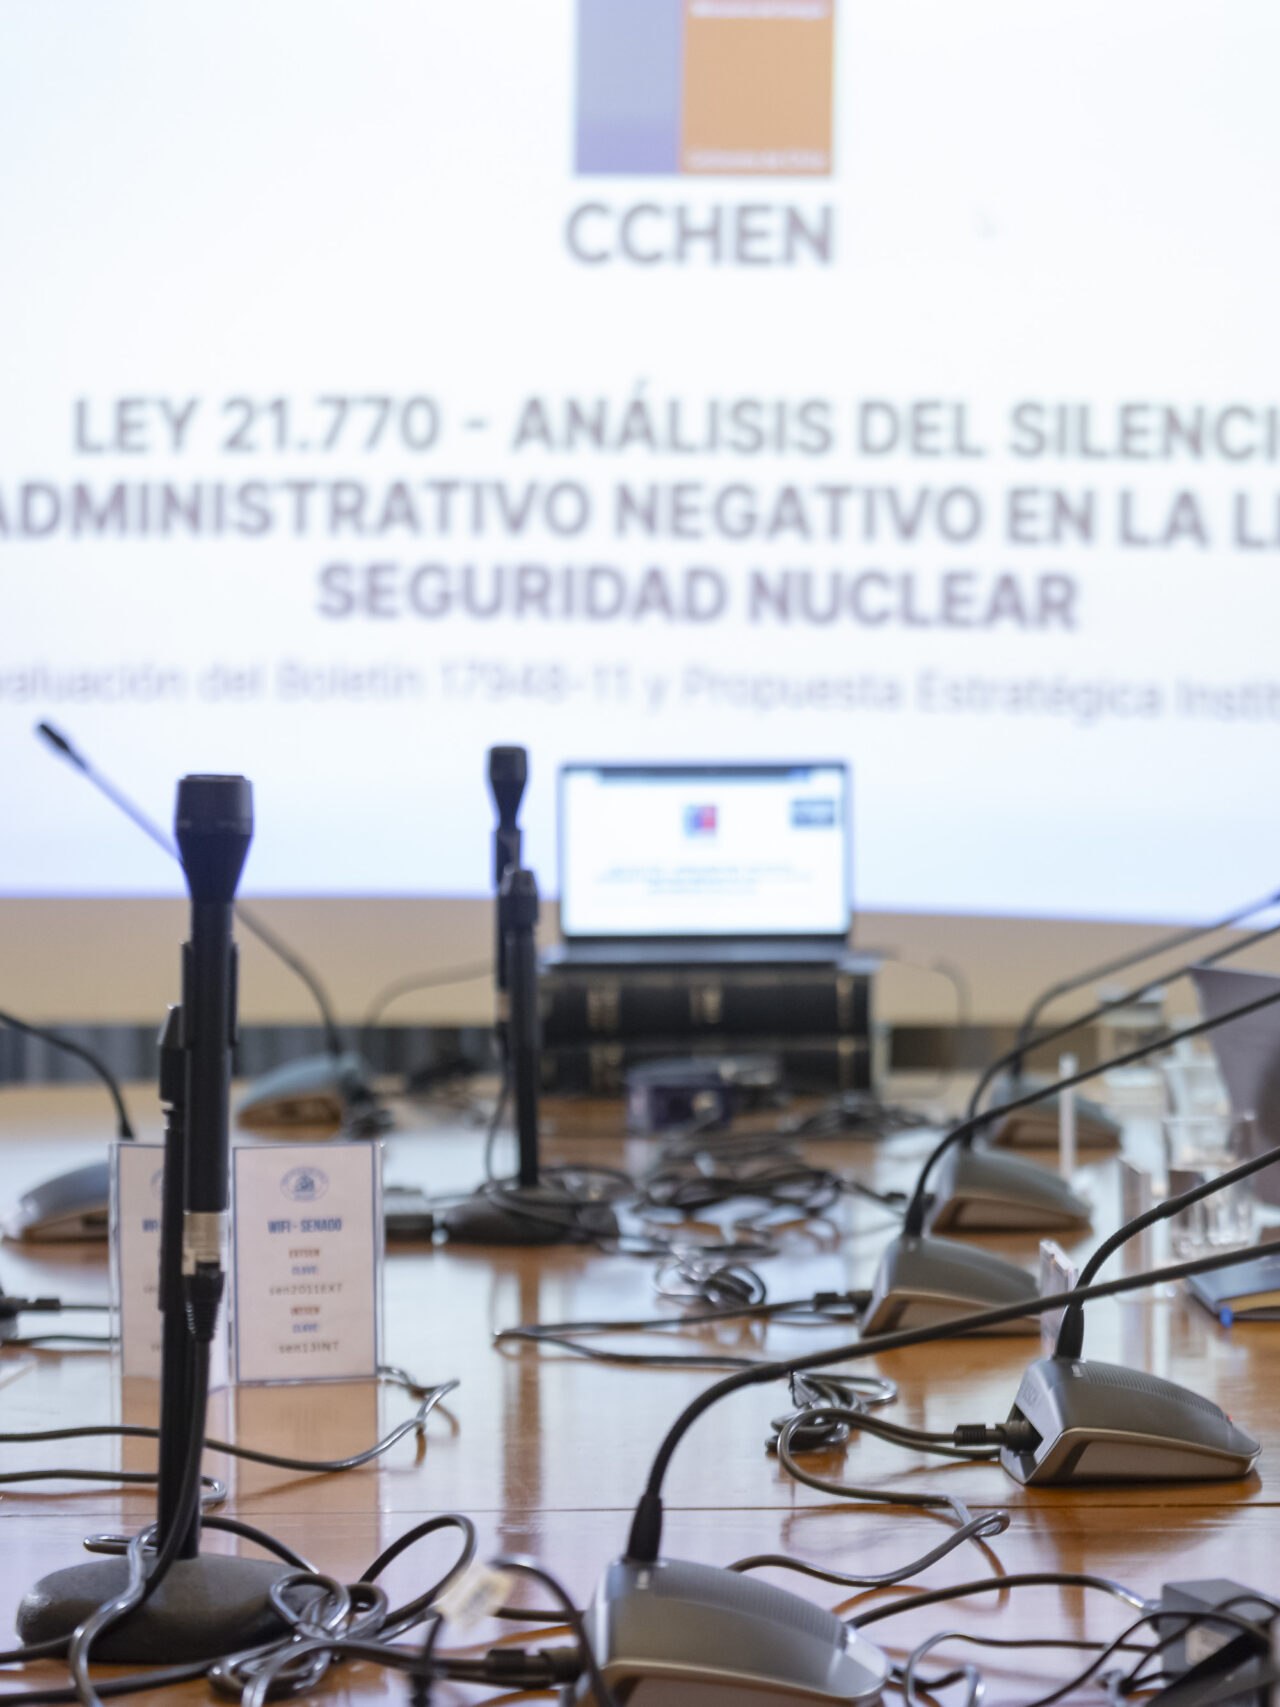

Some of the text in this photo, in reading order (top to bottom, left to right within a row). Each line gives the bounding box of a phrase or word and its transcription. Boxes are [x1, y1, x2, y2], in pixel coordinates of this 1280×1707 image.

[564, 201, 834, 266] CCHEN
[74, 397, 199, 454] LEY
[222, 396, 441, 453] 21.770
[512, 379, 834, 457] ANÁLISIS
[857, 400, 985, 459] DEL
[0, 480, 591, 539] DMINISTRATIVO
[614, 482, 983, 544] NEGATIVO
[1007, 487, 1095, 546] EN
[1118, 489, 1210, 548] LA
[318, 562, 1078, 630] SEGURIDAD NUCLEAR
